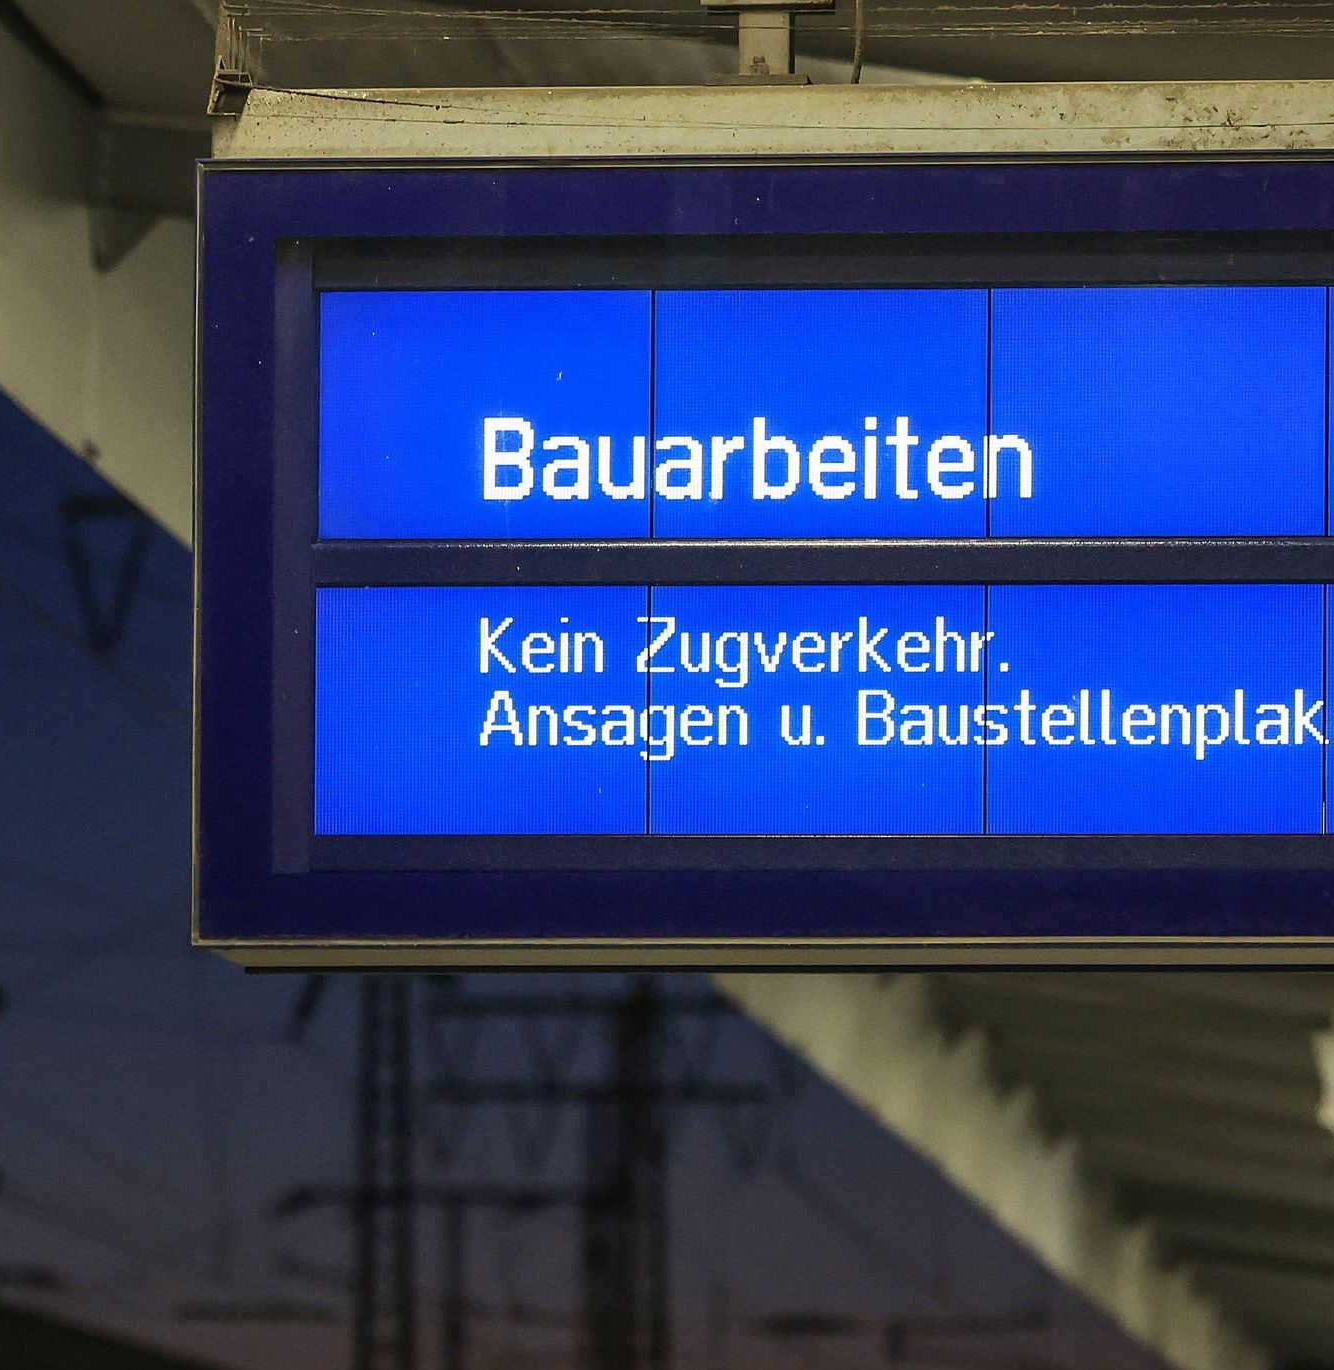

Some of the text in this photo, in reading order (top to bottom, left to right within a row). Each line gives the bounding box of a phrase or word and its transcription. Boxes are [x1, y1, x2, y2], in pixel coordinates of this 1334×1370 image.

[479, 416, 1035, 502] Bauarbeiten
[478, 616, 1011, 688] Kein Zugverkehr.
[478, 689, 749, 760] Ansagen
[781, 703, 826, 746] u.
